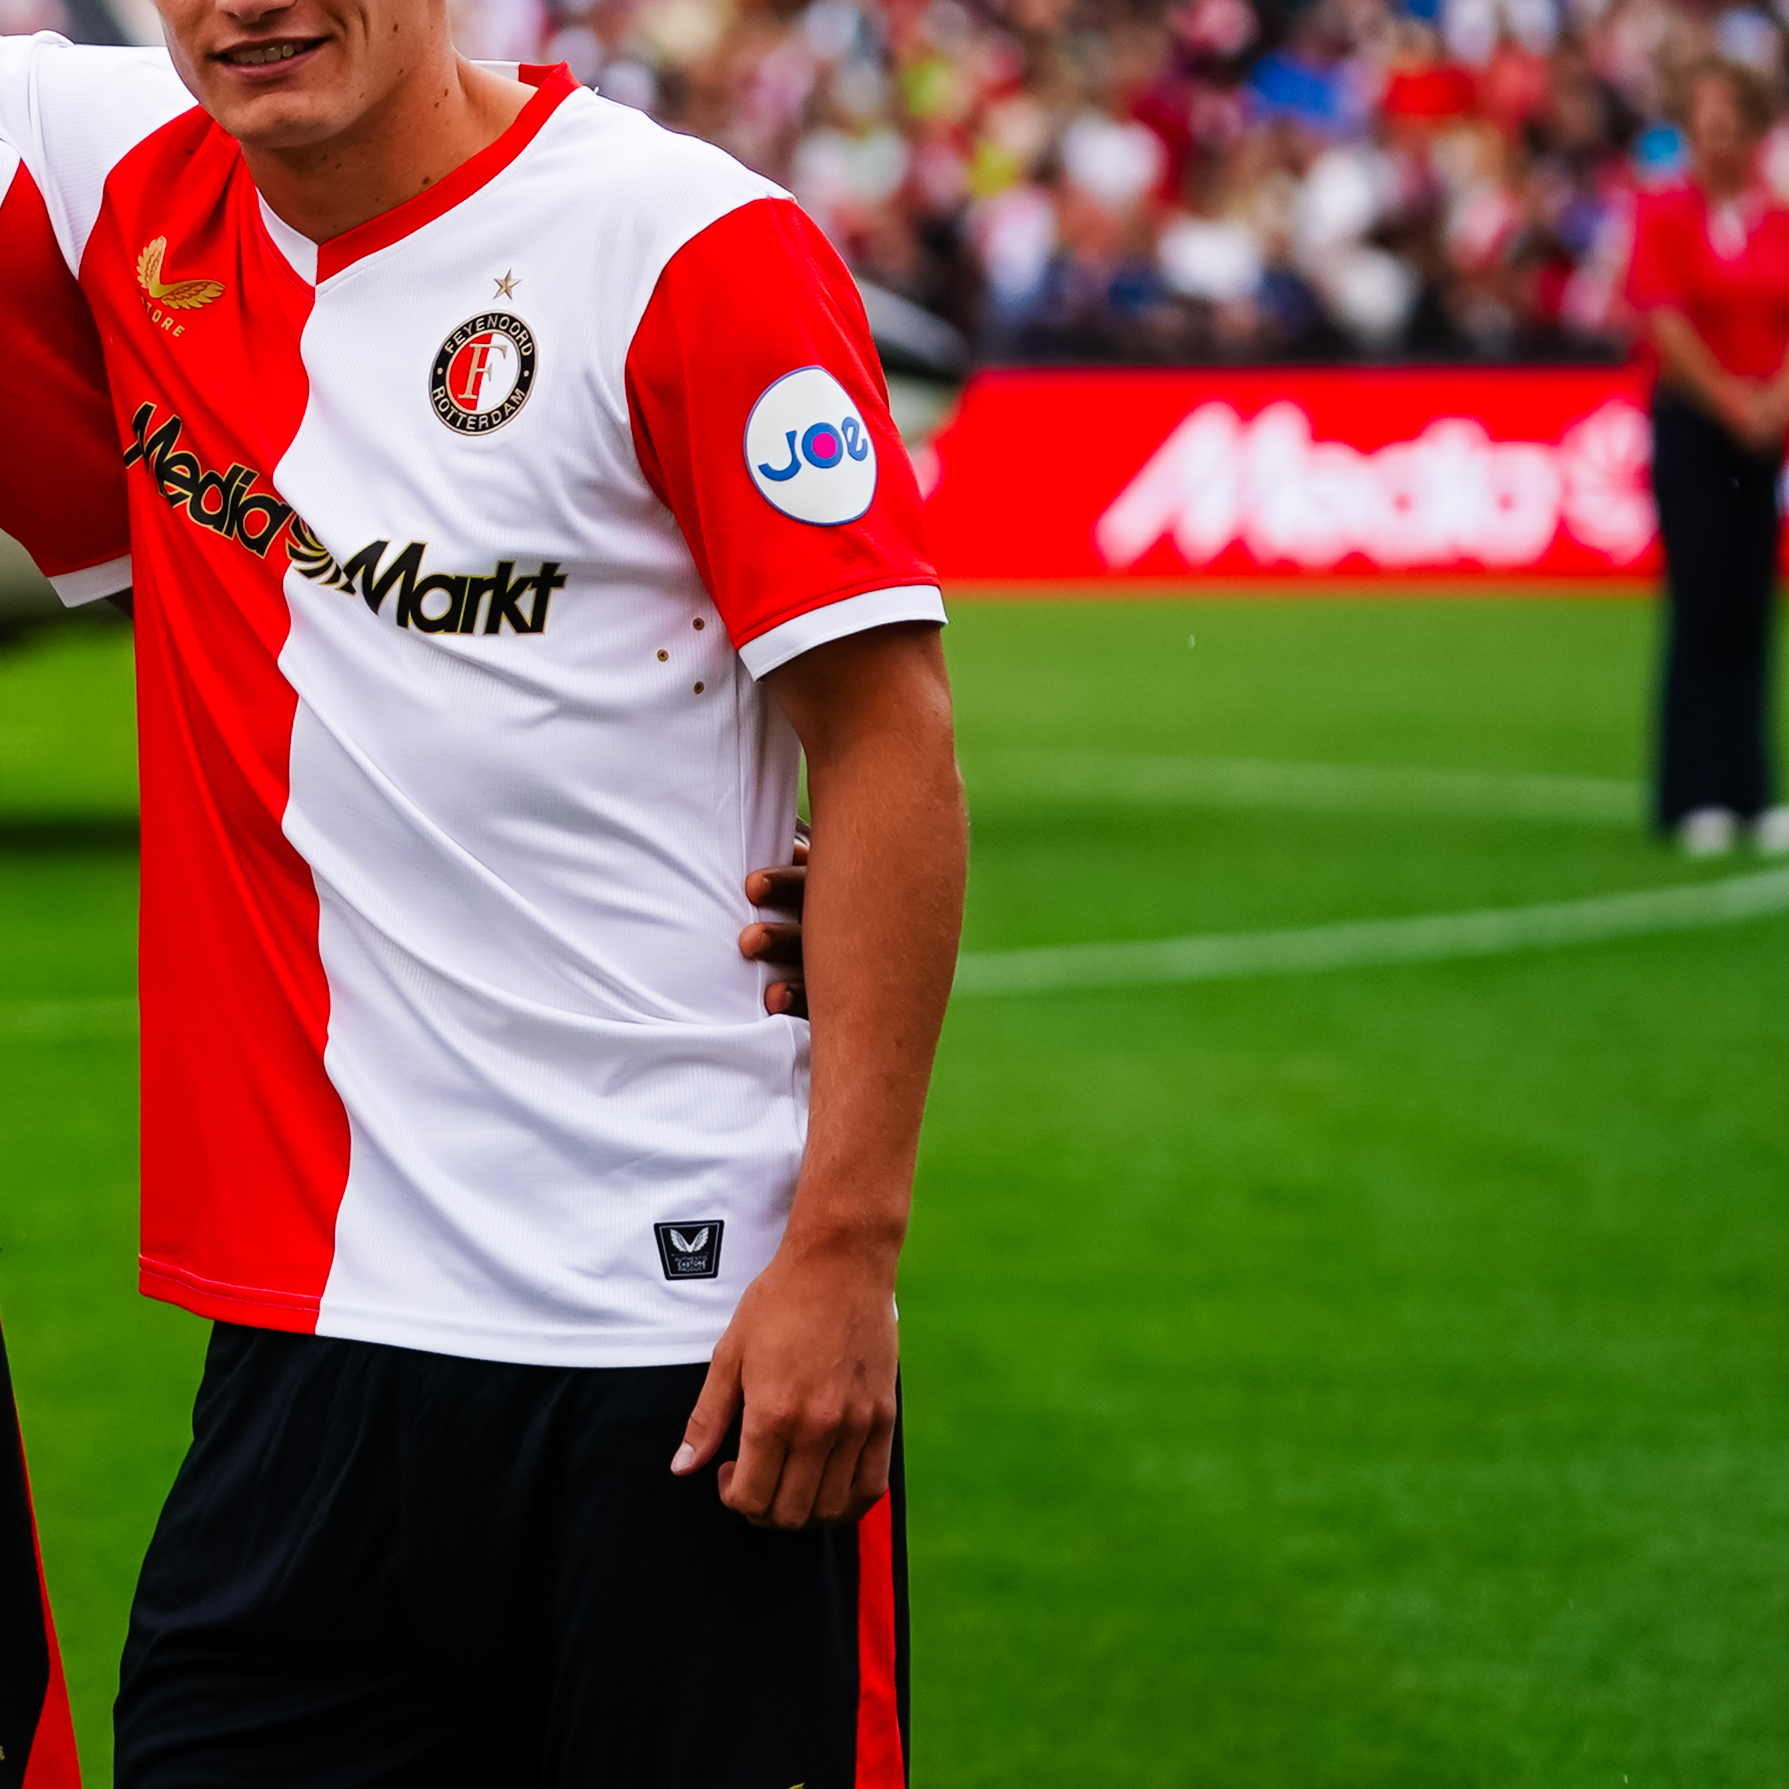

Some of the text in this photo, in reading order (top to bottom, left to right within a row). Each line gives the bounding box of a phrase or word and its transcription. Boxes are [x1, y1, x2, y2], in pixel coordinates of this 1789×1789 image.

[140, 296, 186, 338] TORE
[444, 314, 534, 356] FEYENOORD
[432, 385, 526, 430] ROTTERDAM
[123, 400, 569, 636] Media Markt
